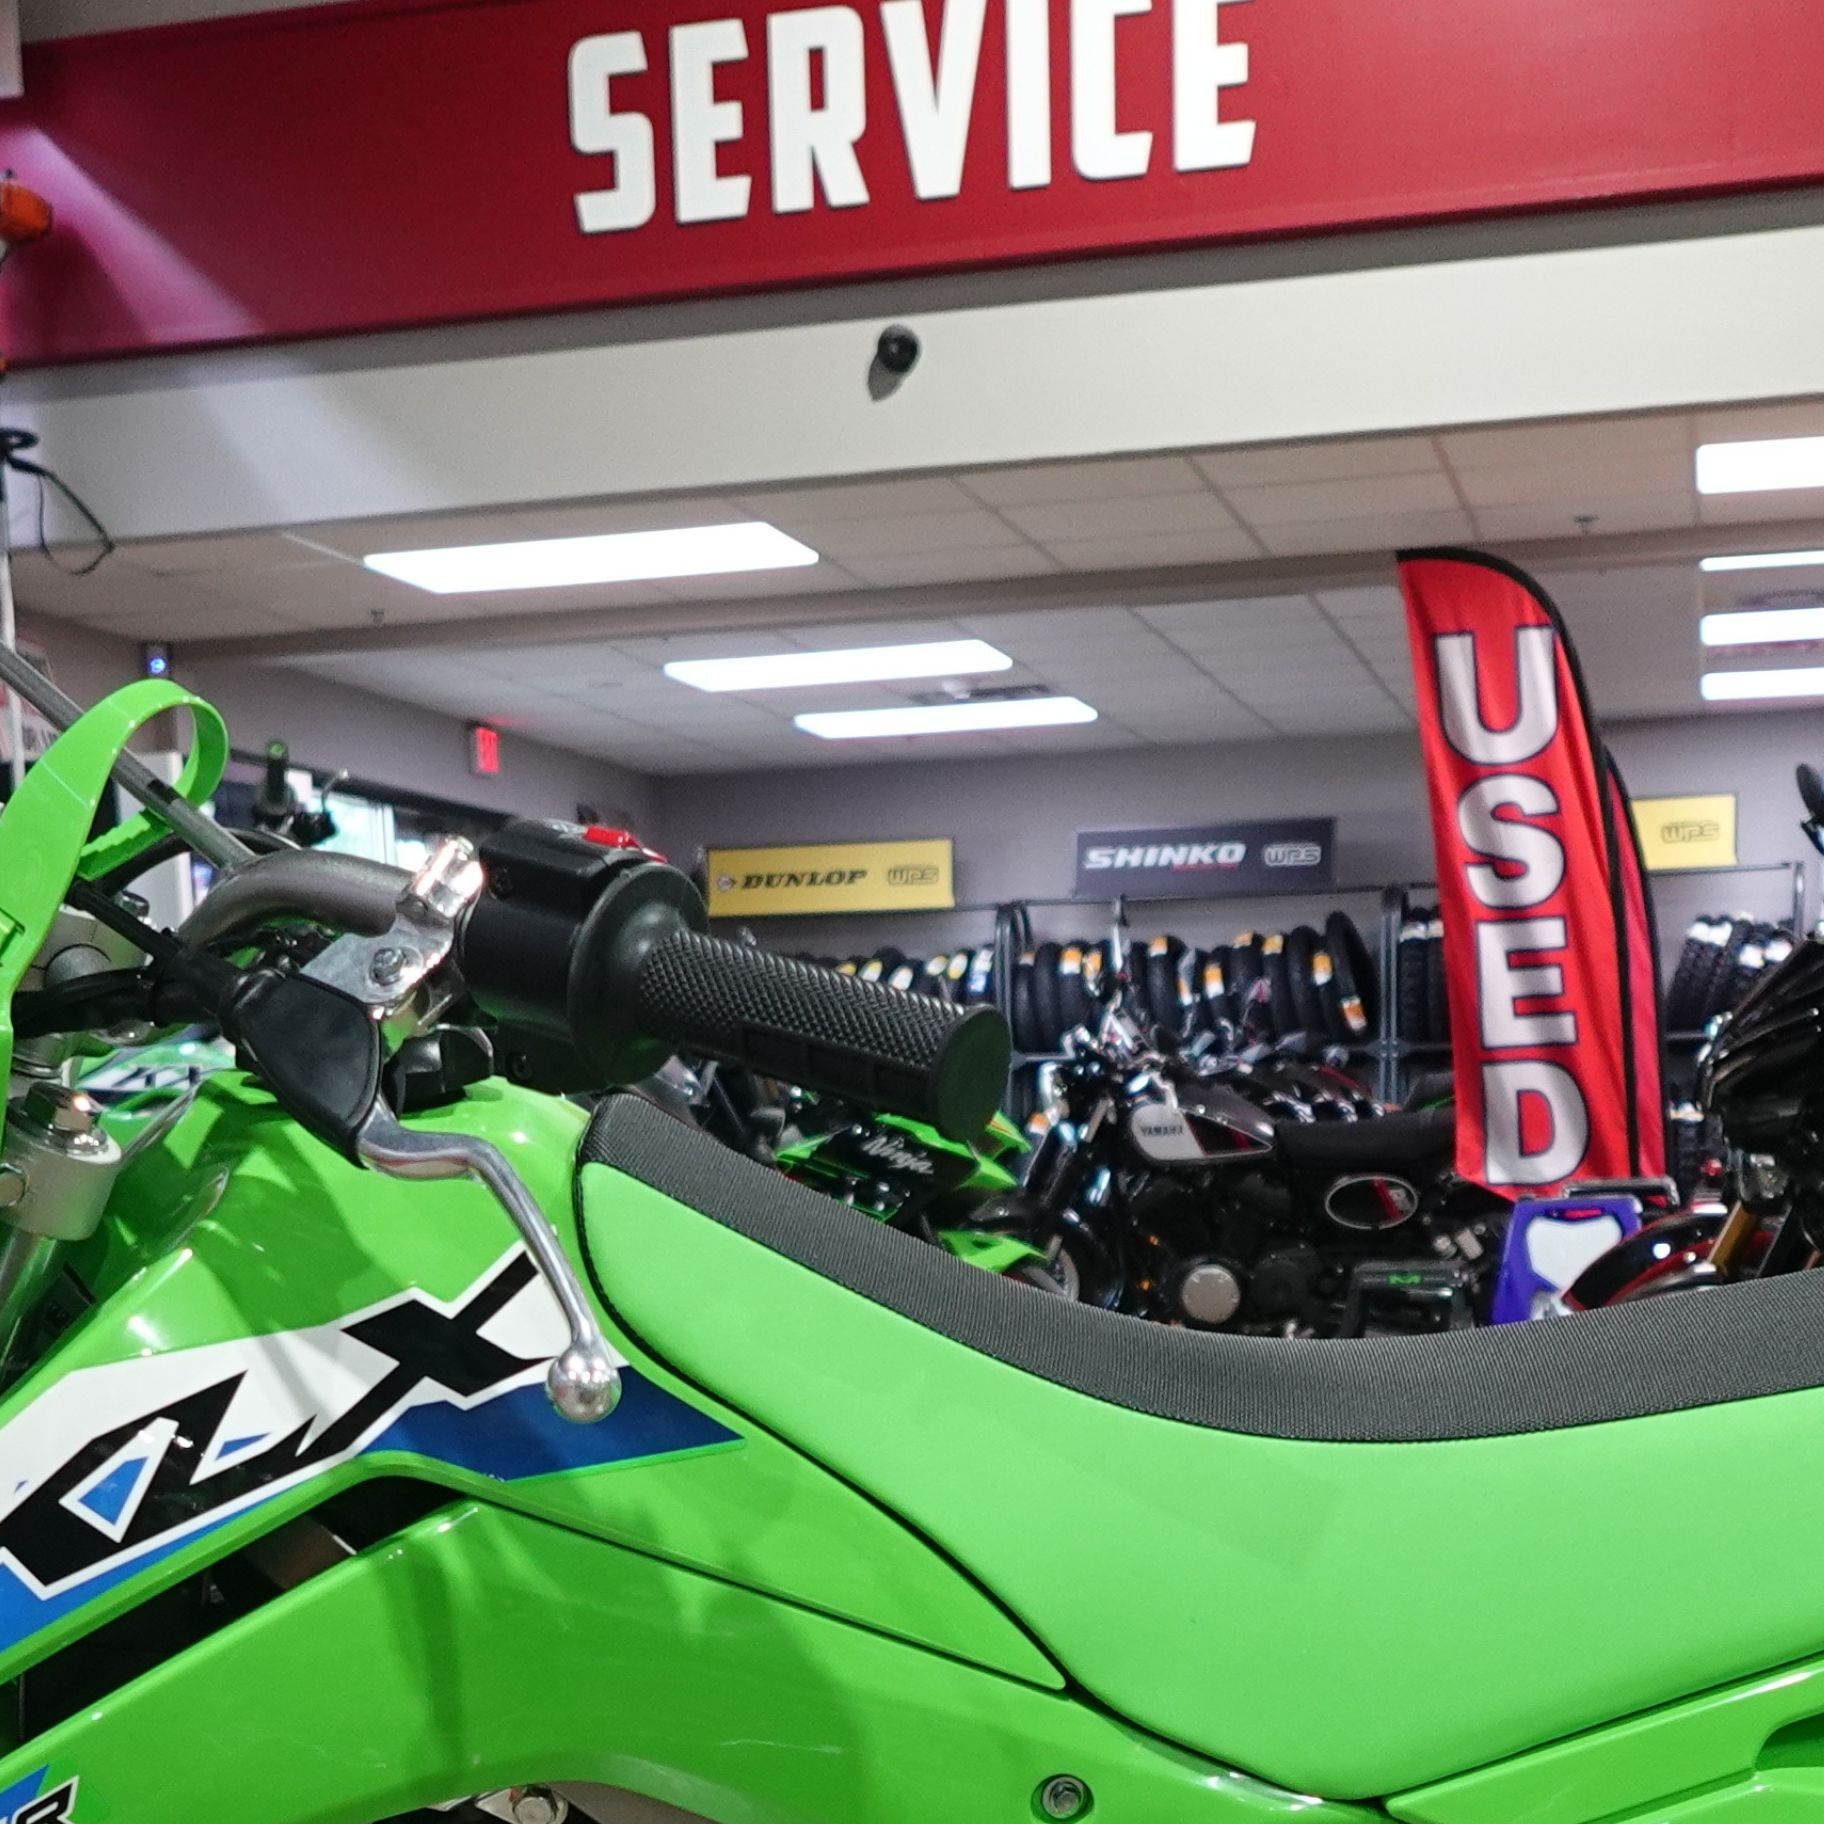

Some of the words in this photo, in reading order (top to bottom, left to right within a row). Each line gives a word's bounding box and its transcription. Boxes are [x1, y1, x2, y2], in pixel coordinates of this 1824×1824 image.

[568, 0, 1257, 233] SERVICE
[1083, 842, 1247, 869] SHINKO
[741, 869, 868, 890] DUNLOP
[1432, 622, 1590, 1188] USED
[1140, 1125, 1185, 1137] YAMAHA
[860, 1135, 935, 1175] Ninja
